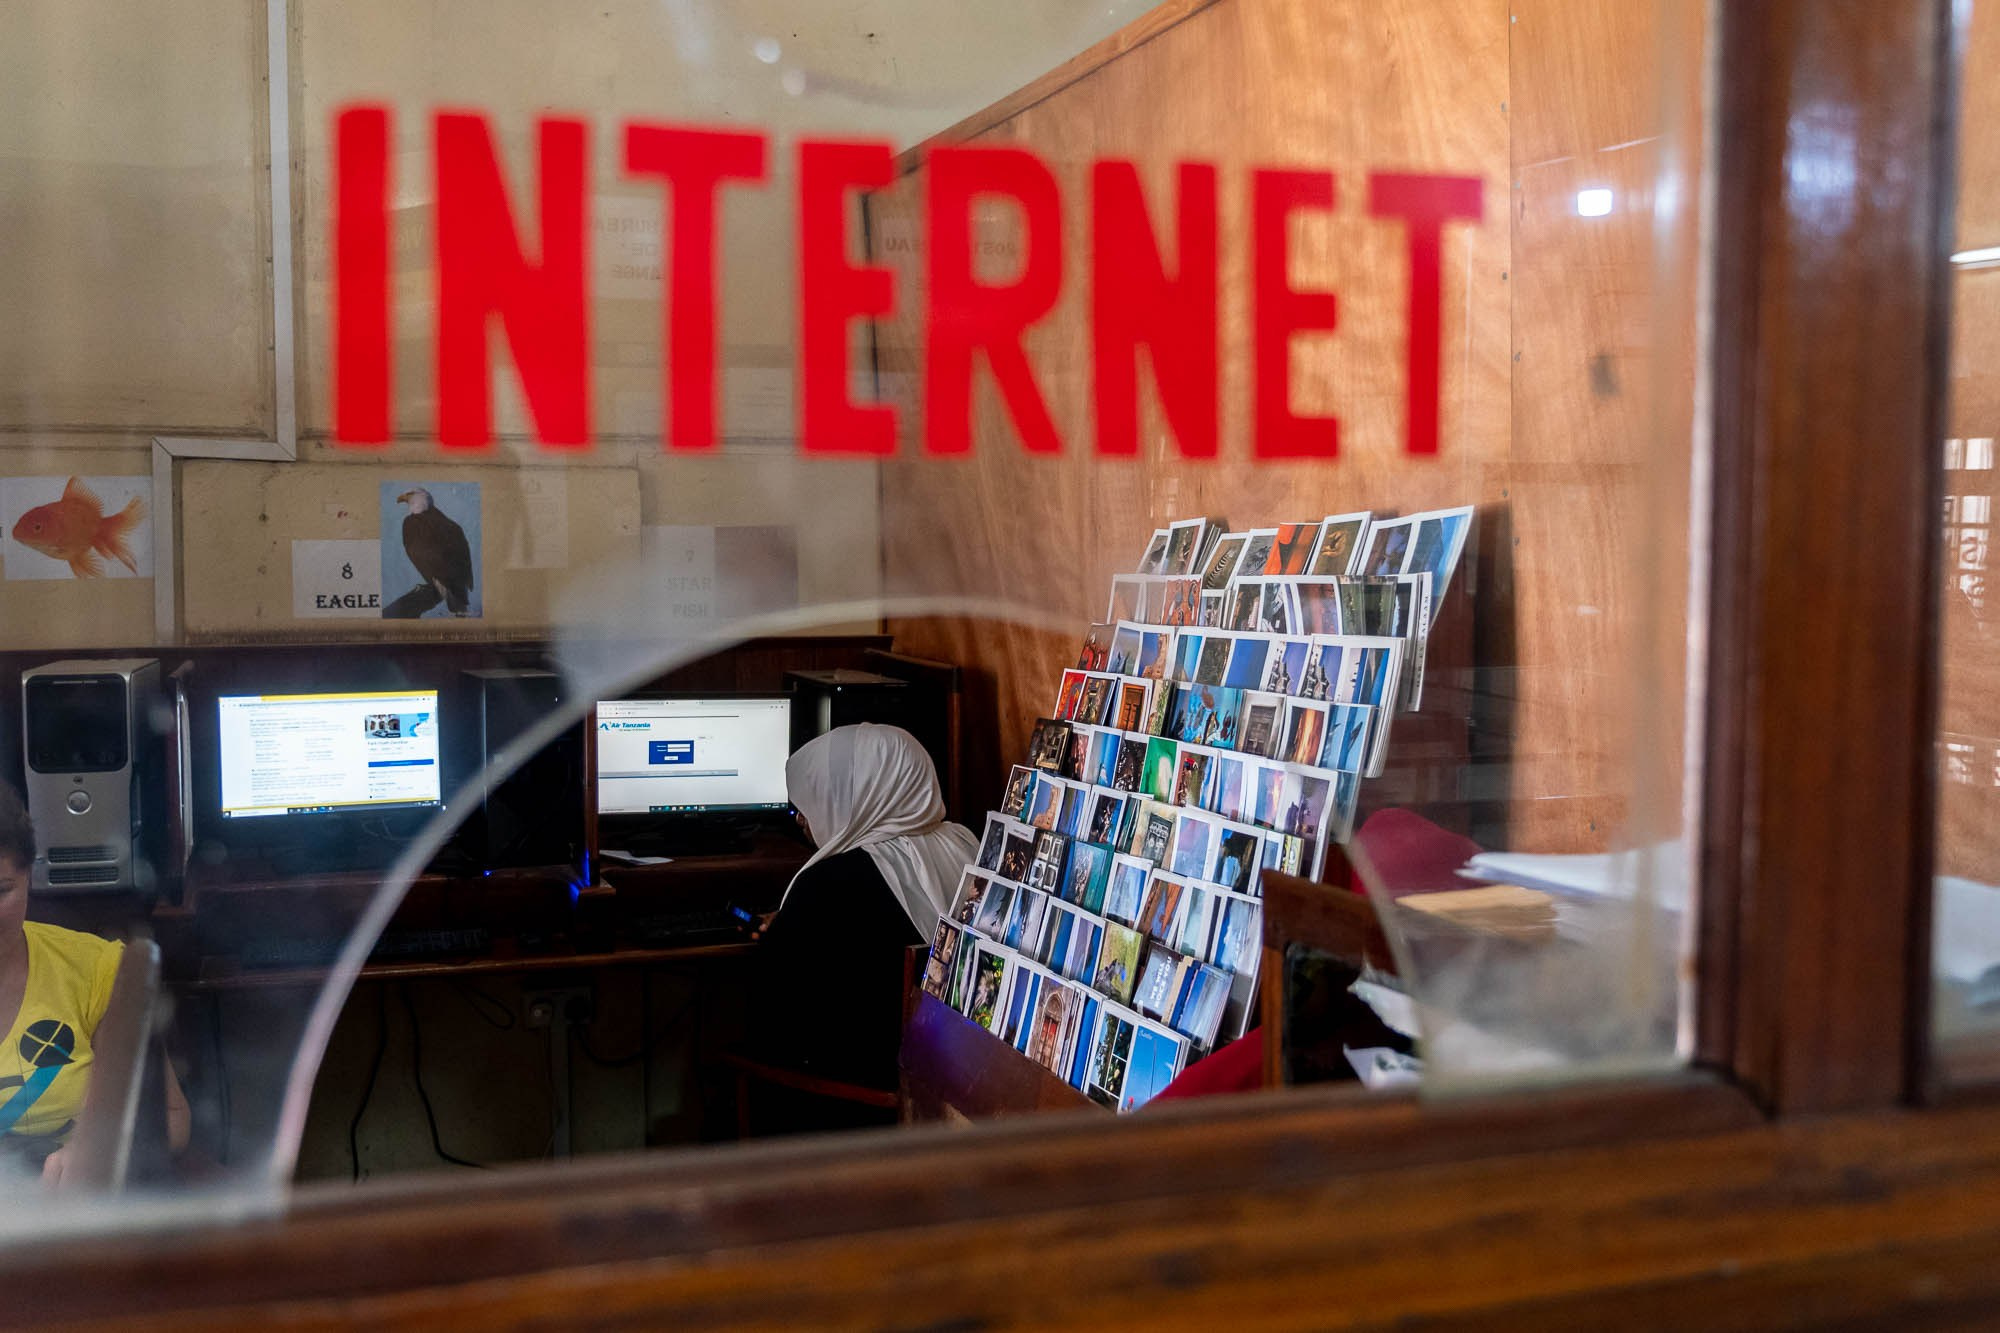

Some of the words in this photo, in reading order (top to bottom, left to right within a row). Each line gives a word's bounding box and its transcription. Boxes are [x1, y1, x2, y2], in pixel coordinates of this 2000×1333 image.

[327, 102, 1486, 462] INTERNET
[342, 562, 353, 580] 8
[664, 576, 712, 592] STAR
[316, 594, 380, 609] EAGLE
[672, 602, 706, 618] FISH
[1163, 956, 1172, 977] YOU
